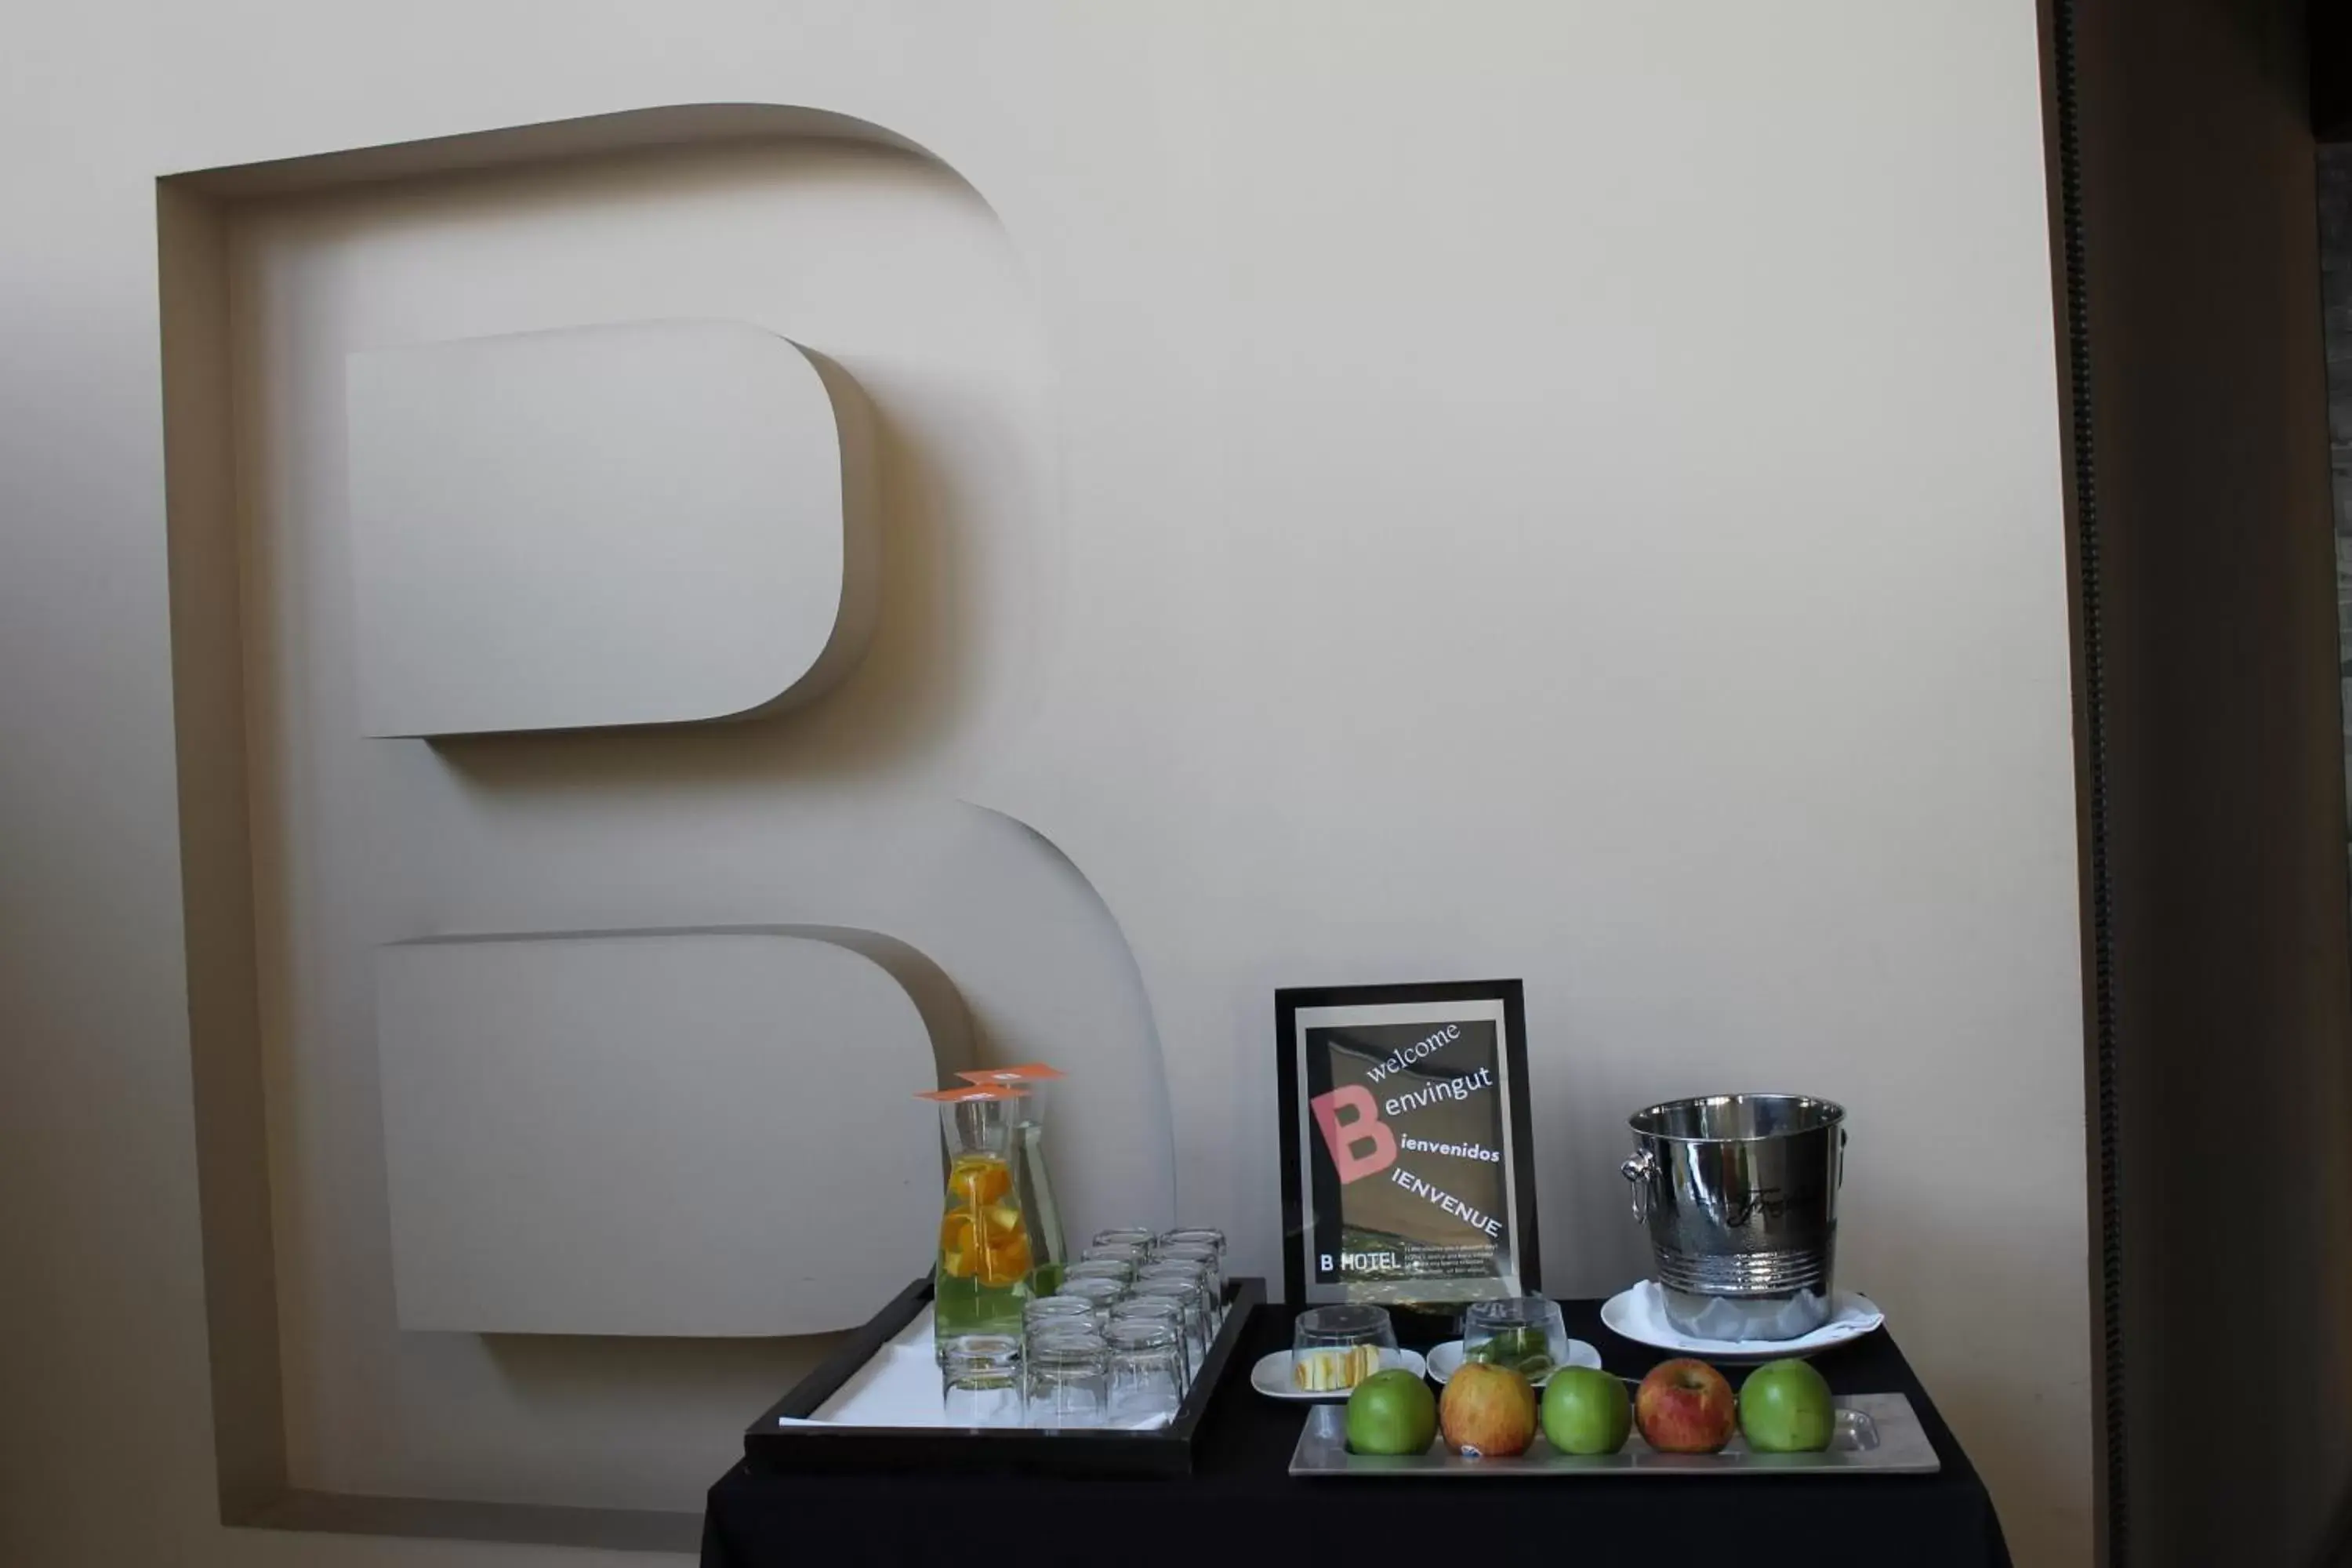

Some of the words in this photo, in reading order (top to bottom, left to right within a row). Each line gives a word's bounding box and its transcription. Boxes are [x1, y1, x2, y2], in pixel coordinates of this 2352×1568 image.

[1367, 1024, 1461, 1084] welcome
[1385, 1066, 1493, 1116] envingut
[1311, 1083, 1397, 1185] B
[1400, 1133, 1500, 1163] ienvenidos
[1392, 1167, 1503, 1239] IENVENUE
[1320, 1254, 1333, 1272] B
[1341, 1252, 1402, 1271] HOTEL
